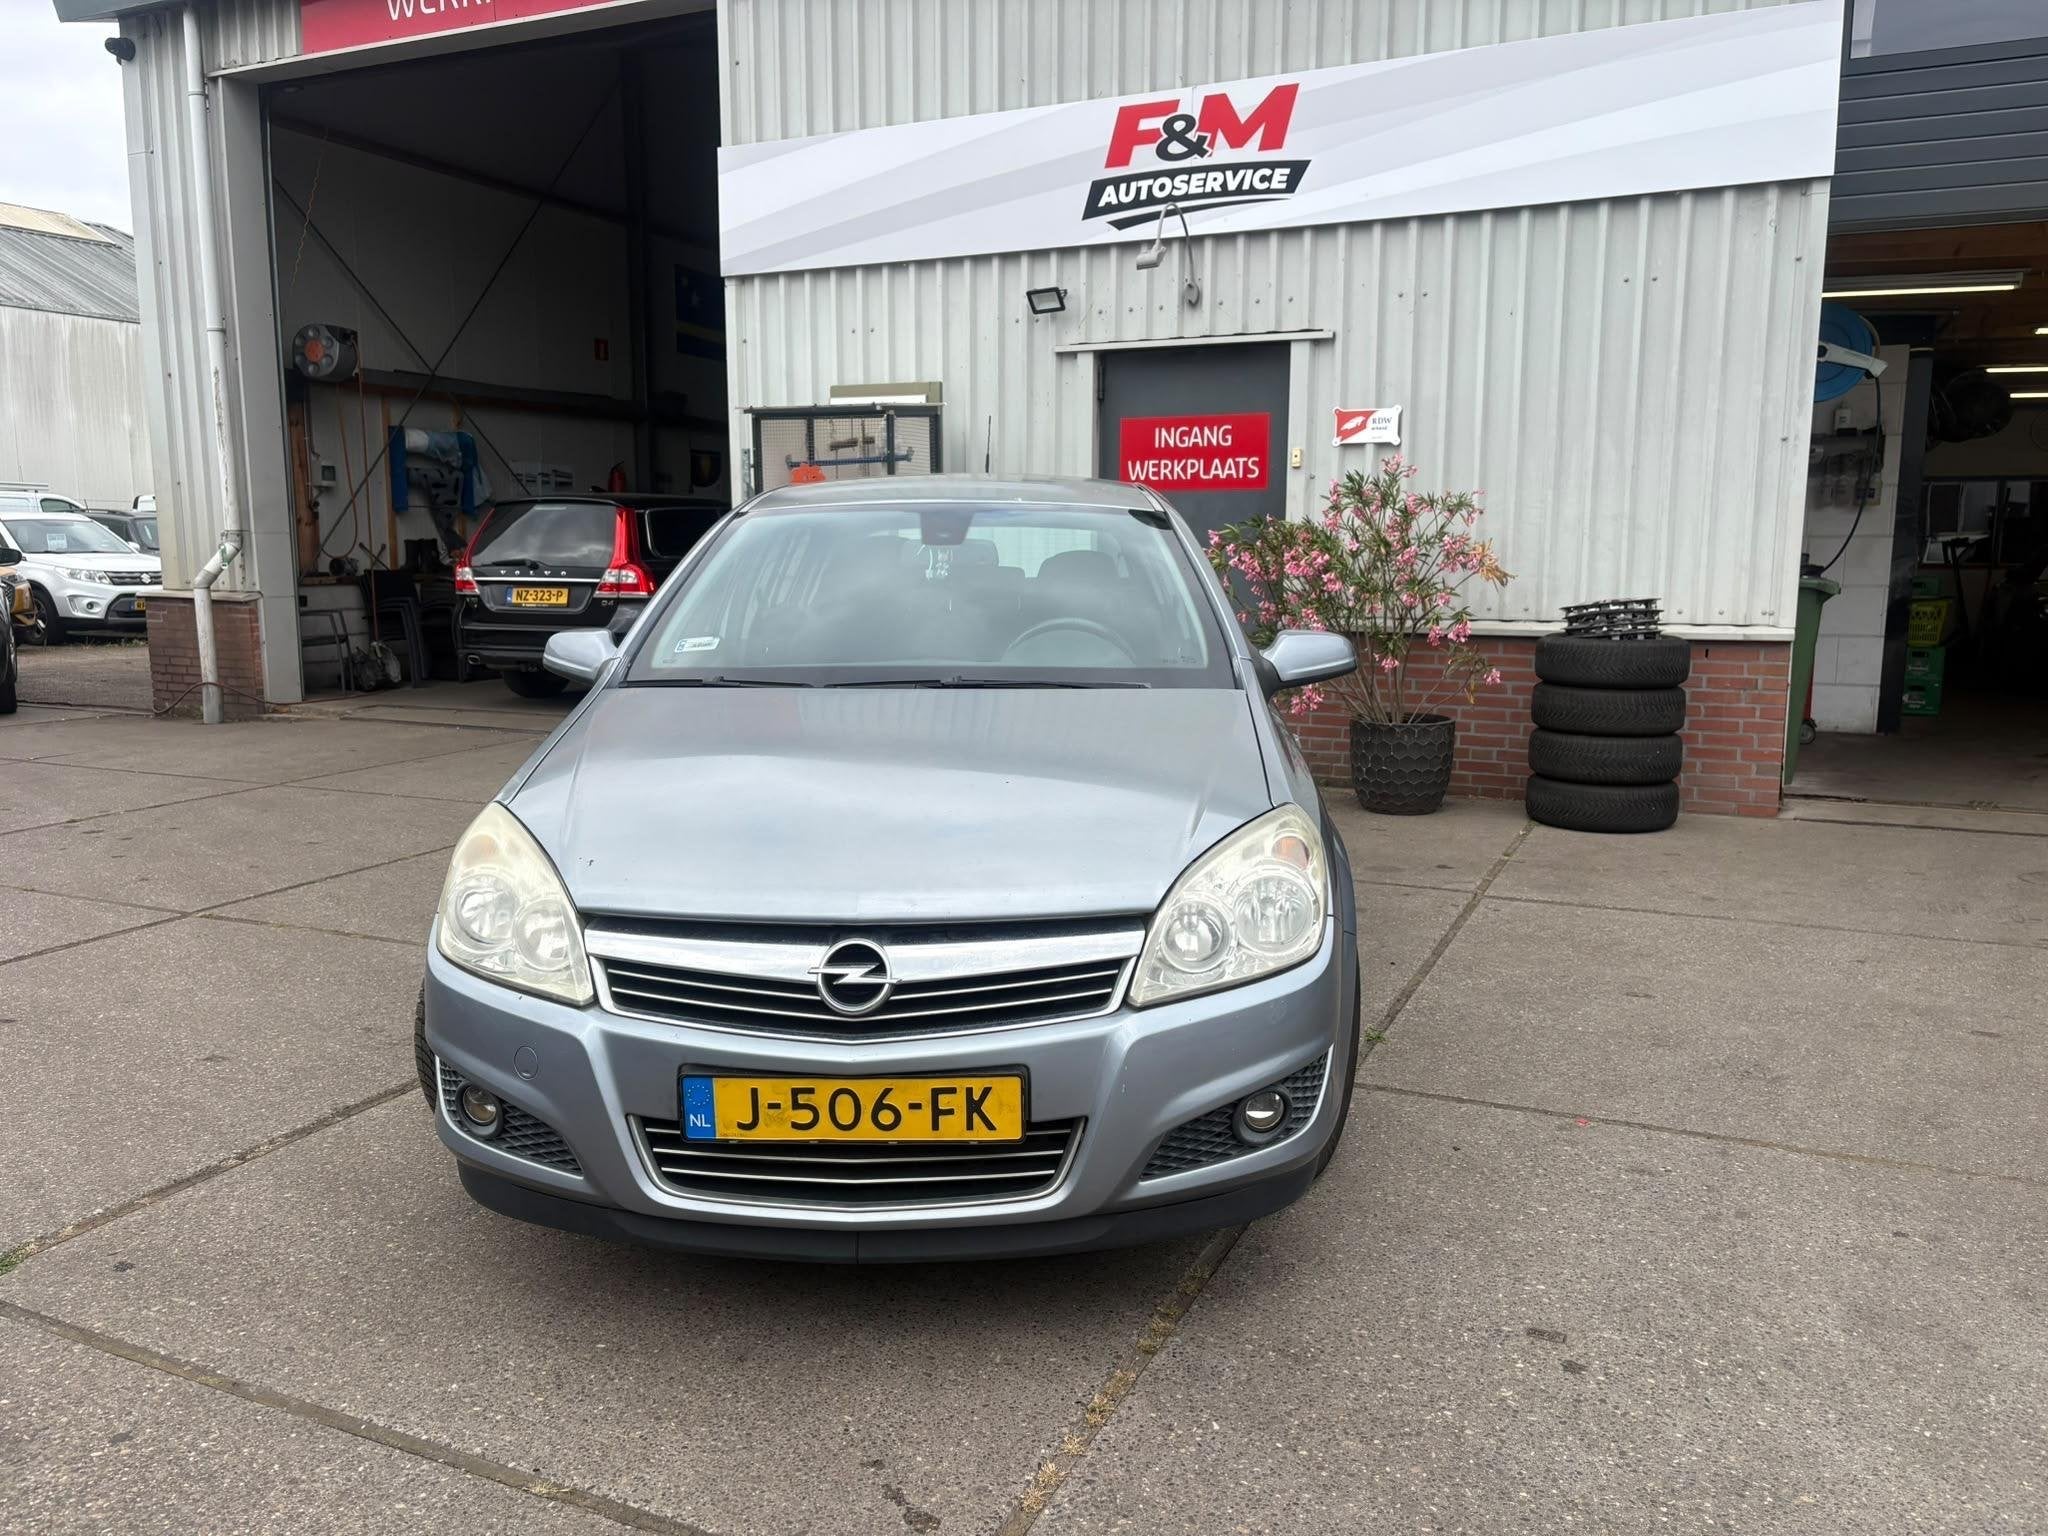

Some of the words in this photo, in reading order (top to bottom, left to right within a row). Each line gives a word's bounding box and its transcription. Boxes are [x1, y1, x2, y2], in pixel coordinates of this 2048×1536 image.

[1104, 83, 1300, 169] F&M
[1097, 167, 1291, 207] AUTOSERVICE
[1154, 425, 1232, 448] INGANG
[1127, 457, 1260, 481] WERKPLAATS
[515, 589, 563, 602] NZ-323-P
[689, 1114, 711, 1128] NL
[736, 1086, 997, 1132] J-506-FK
